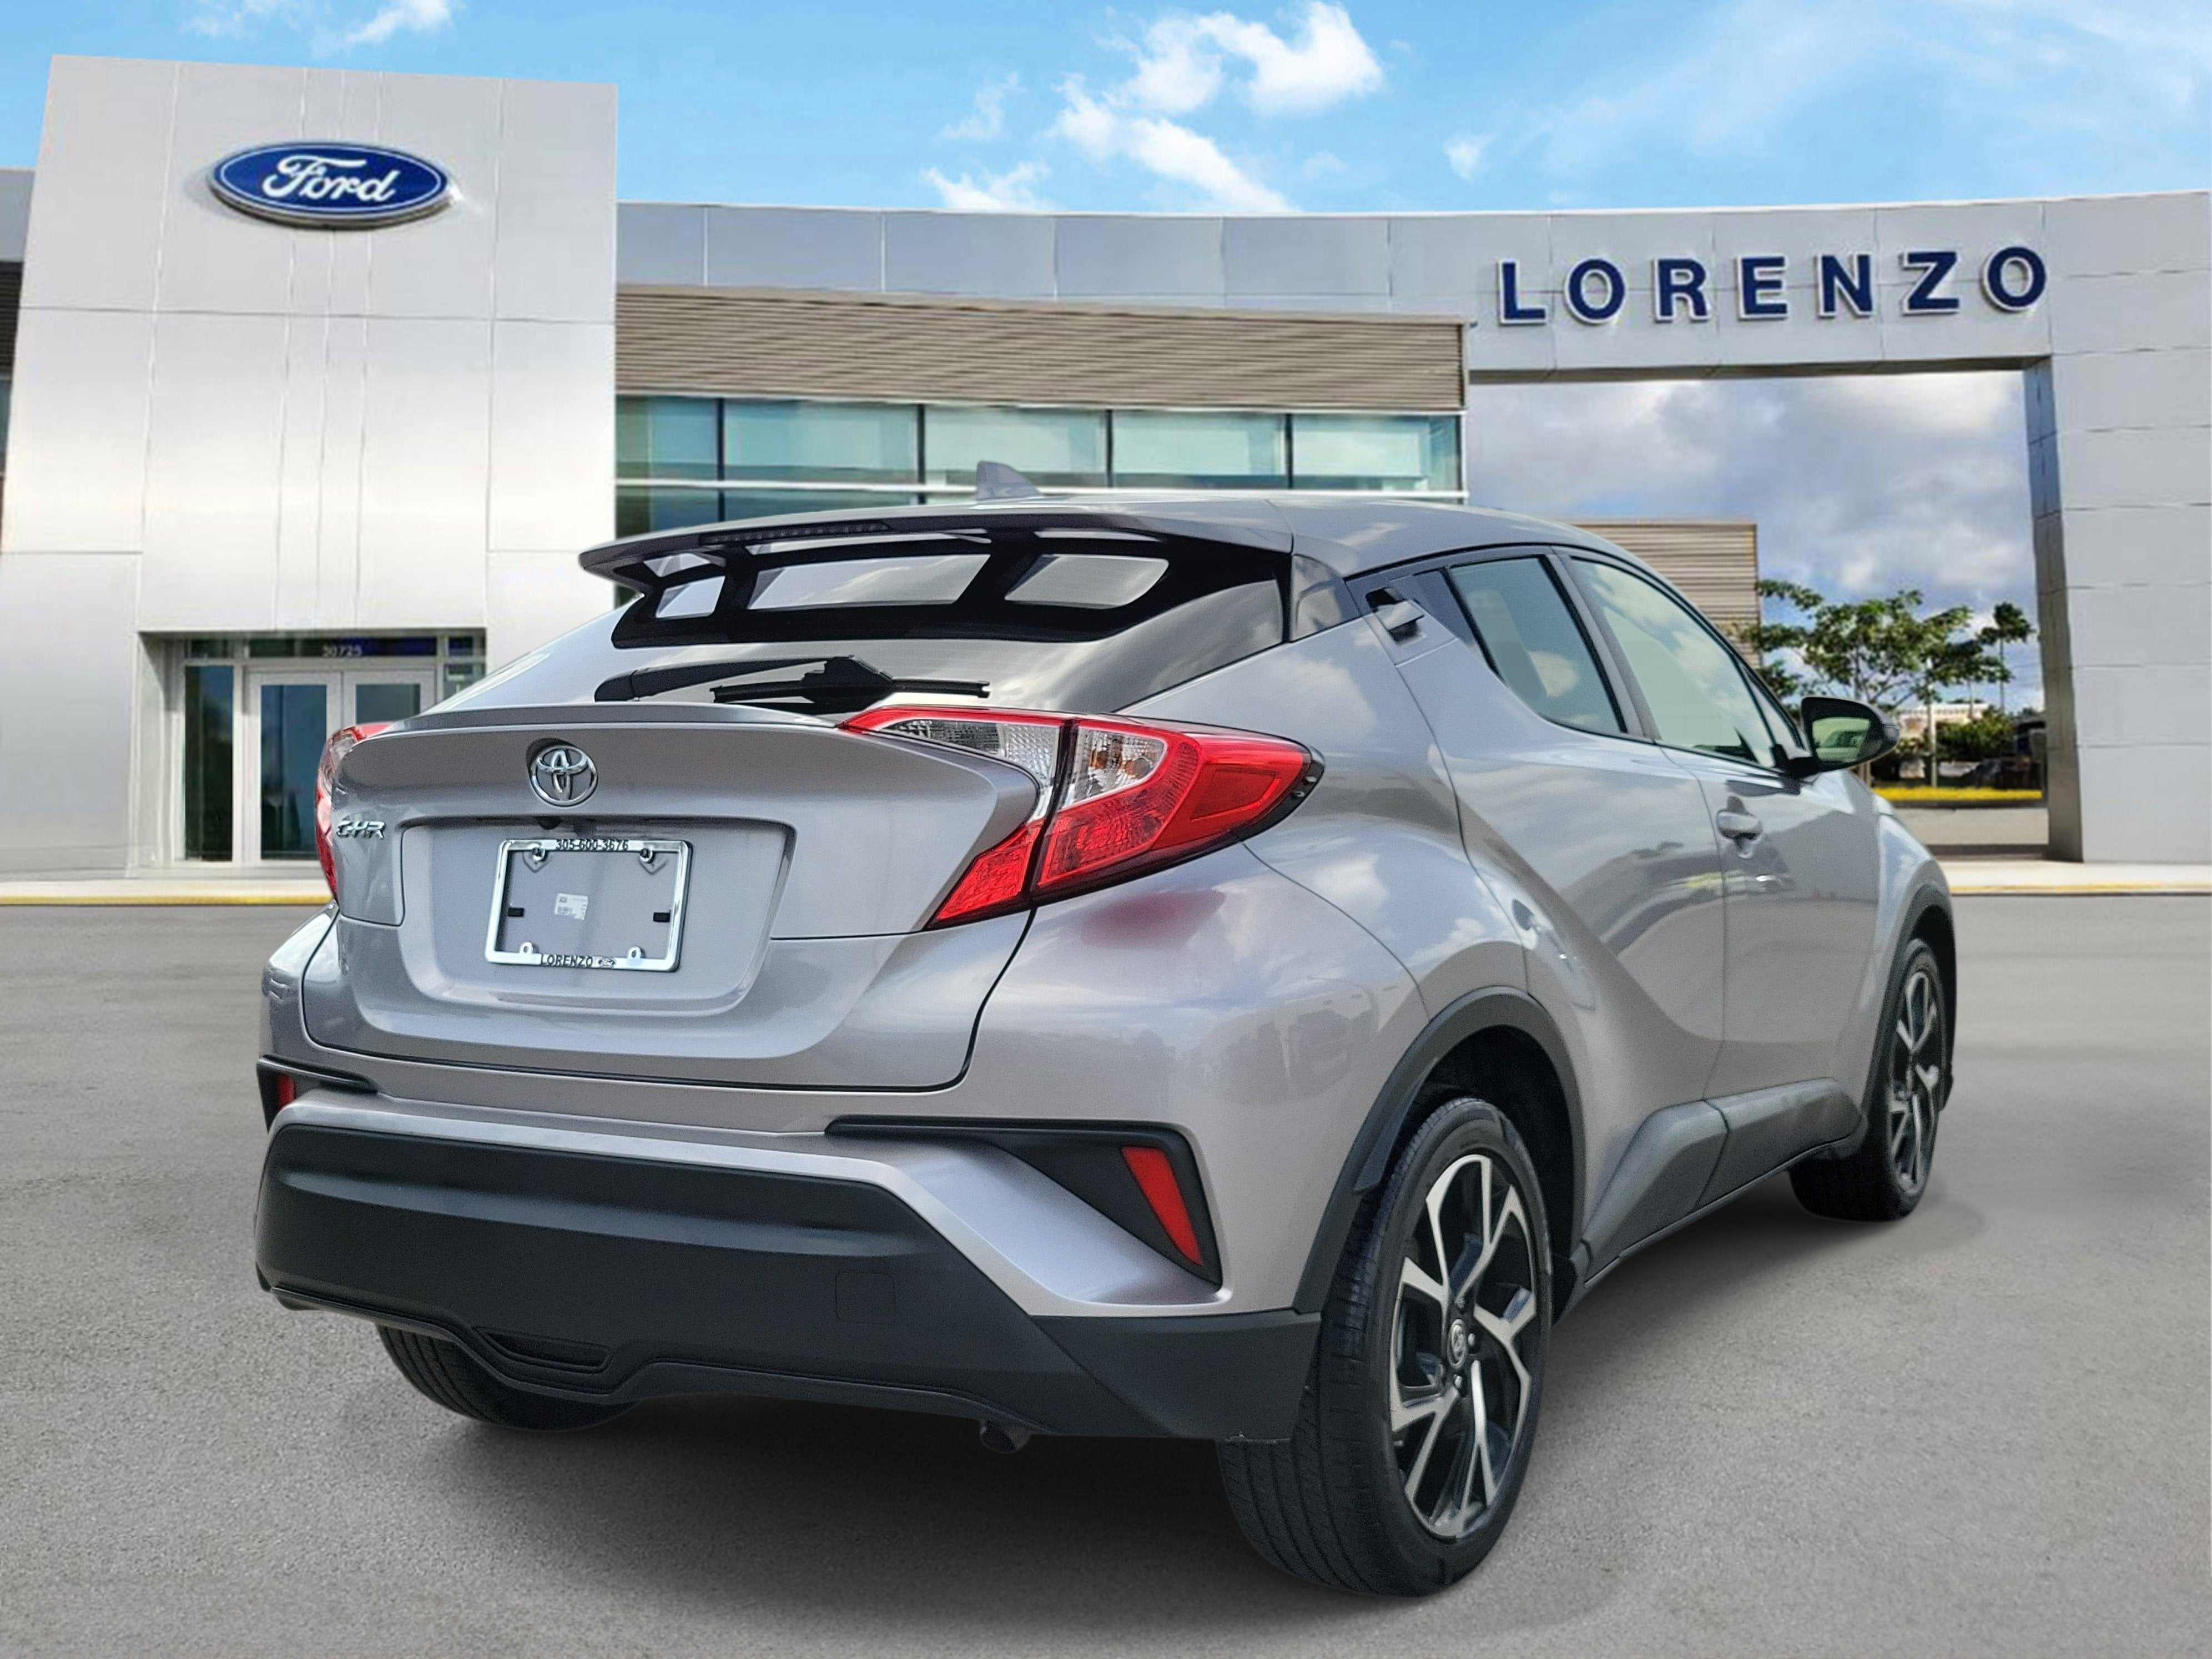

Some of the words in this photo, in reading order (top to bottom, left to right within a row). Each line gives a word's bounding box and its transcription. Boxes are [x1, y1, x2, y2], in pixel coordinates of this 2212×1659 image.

[262, 154, 400, 201] Ford
[1499, 246, 2047, 324] LORENZO
[540, 953, 593, 967] LORENZO
